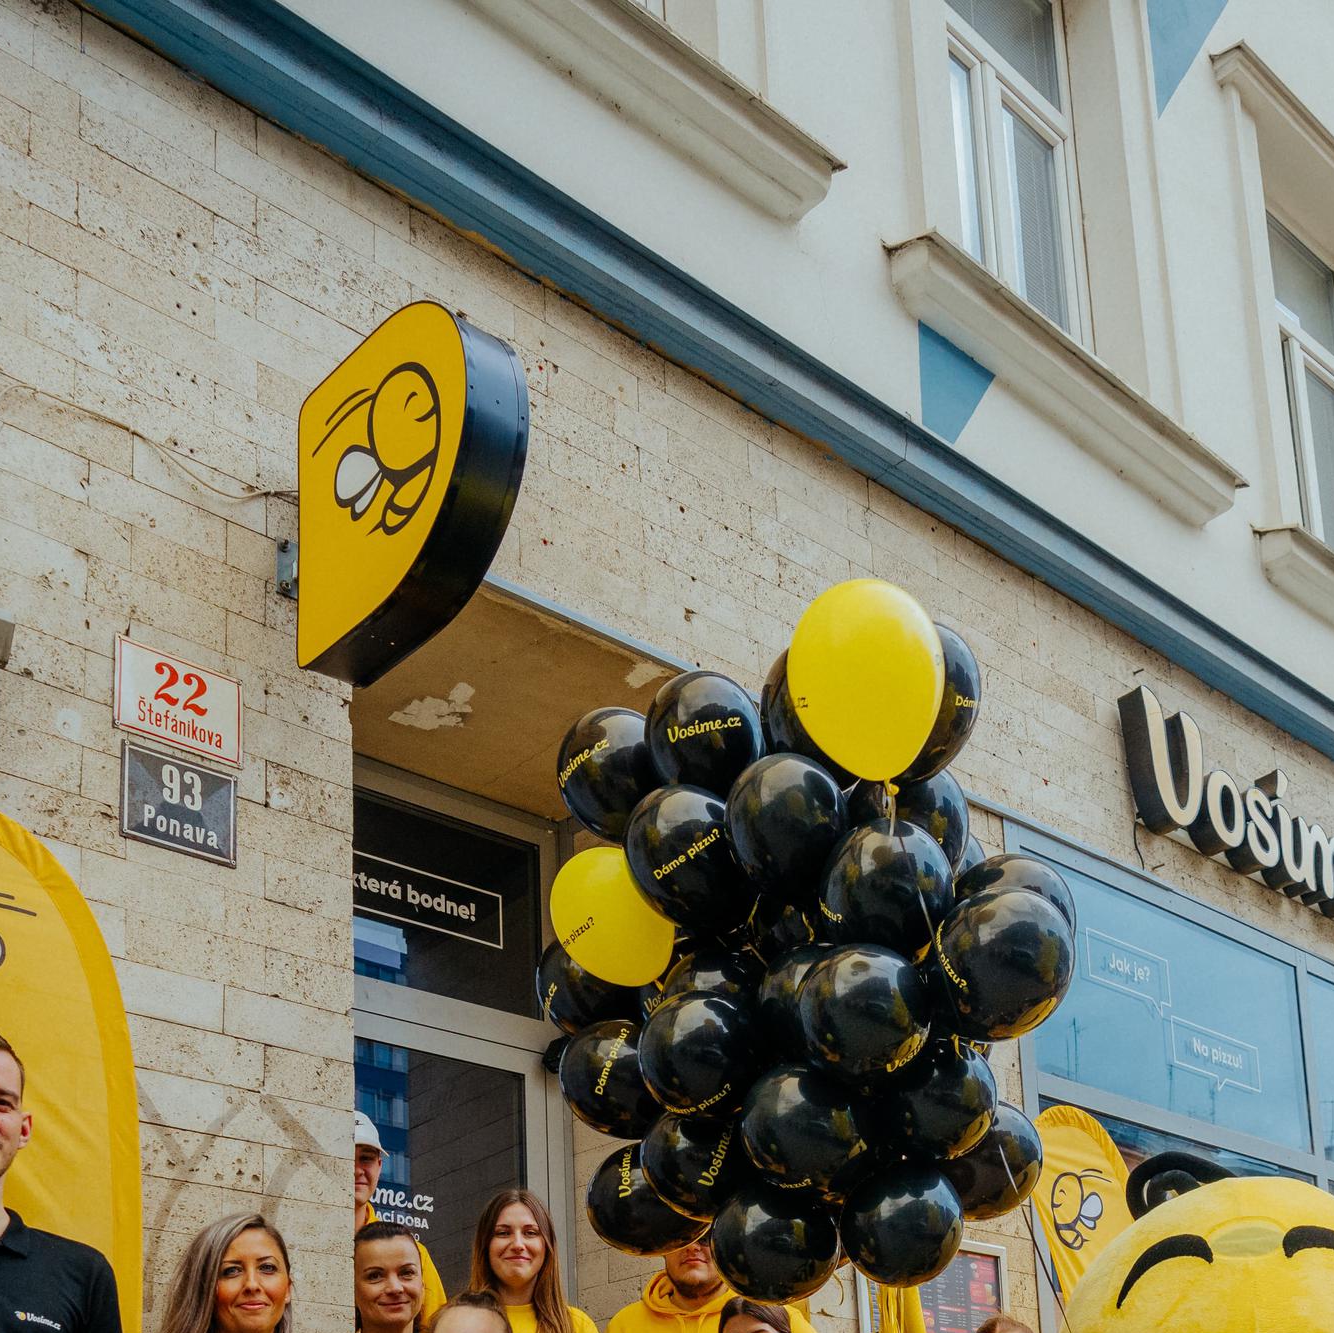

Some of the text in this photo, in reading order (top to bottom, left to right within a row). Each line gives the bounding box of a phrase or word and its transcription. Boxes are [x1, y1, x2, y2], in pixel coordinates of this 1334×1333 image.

[153, 661, 208, 717] 22
[955, 694, 978, 708] Dám
[138, 695, 223, 750] Štefánikova
[667, 714, 742, 744] Vosíme.cz
[558, 737, 610, 789] Vosíme.cz
[161, 764, 203, 812] 93
[143, 804, 220, 850] Ponava
[653, 828, 720, 881] Dáme pizzu?
[407, 884, 476, 922] bodne!
[571, 916, 596, 943] pizzu?
[1109, 952, 1151, 982] Jak je?
[595, 1027, 631, 1096] Dáme pizzu?
[1193, 1038, 1243, 1070] Na pizzu!
[698, 1083, 733, 1112] pizzu?
[367, 1186, 434, 1213] me.cz
[396, 1214, 429, 1230] DOBA
